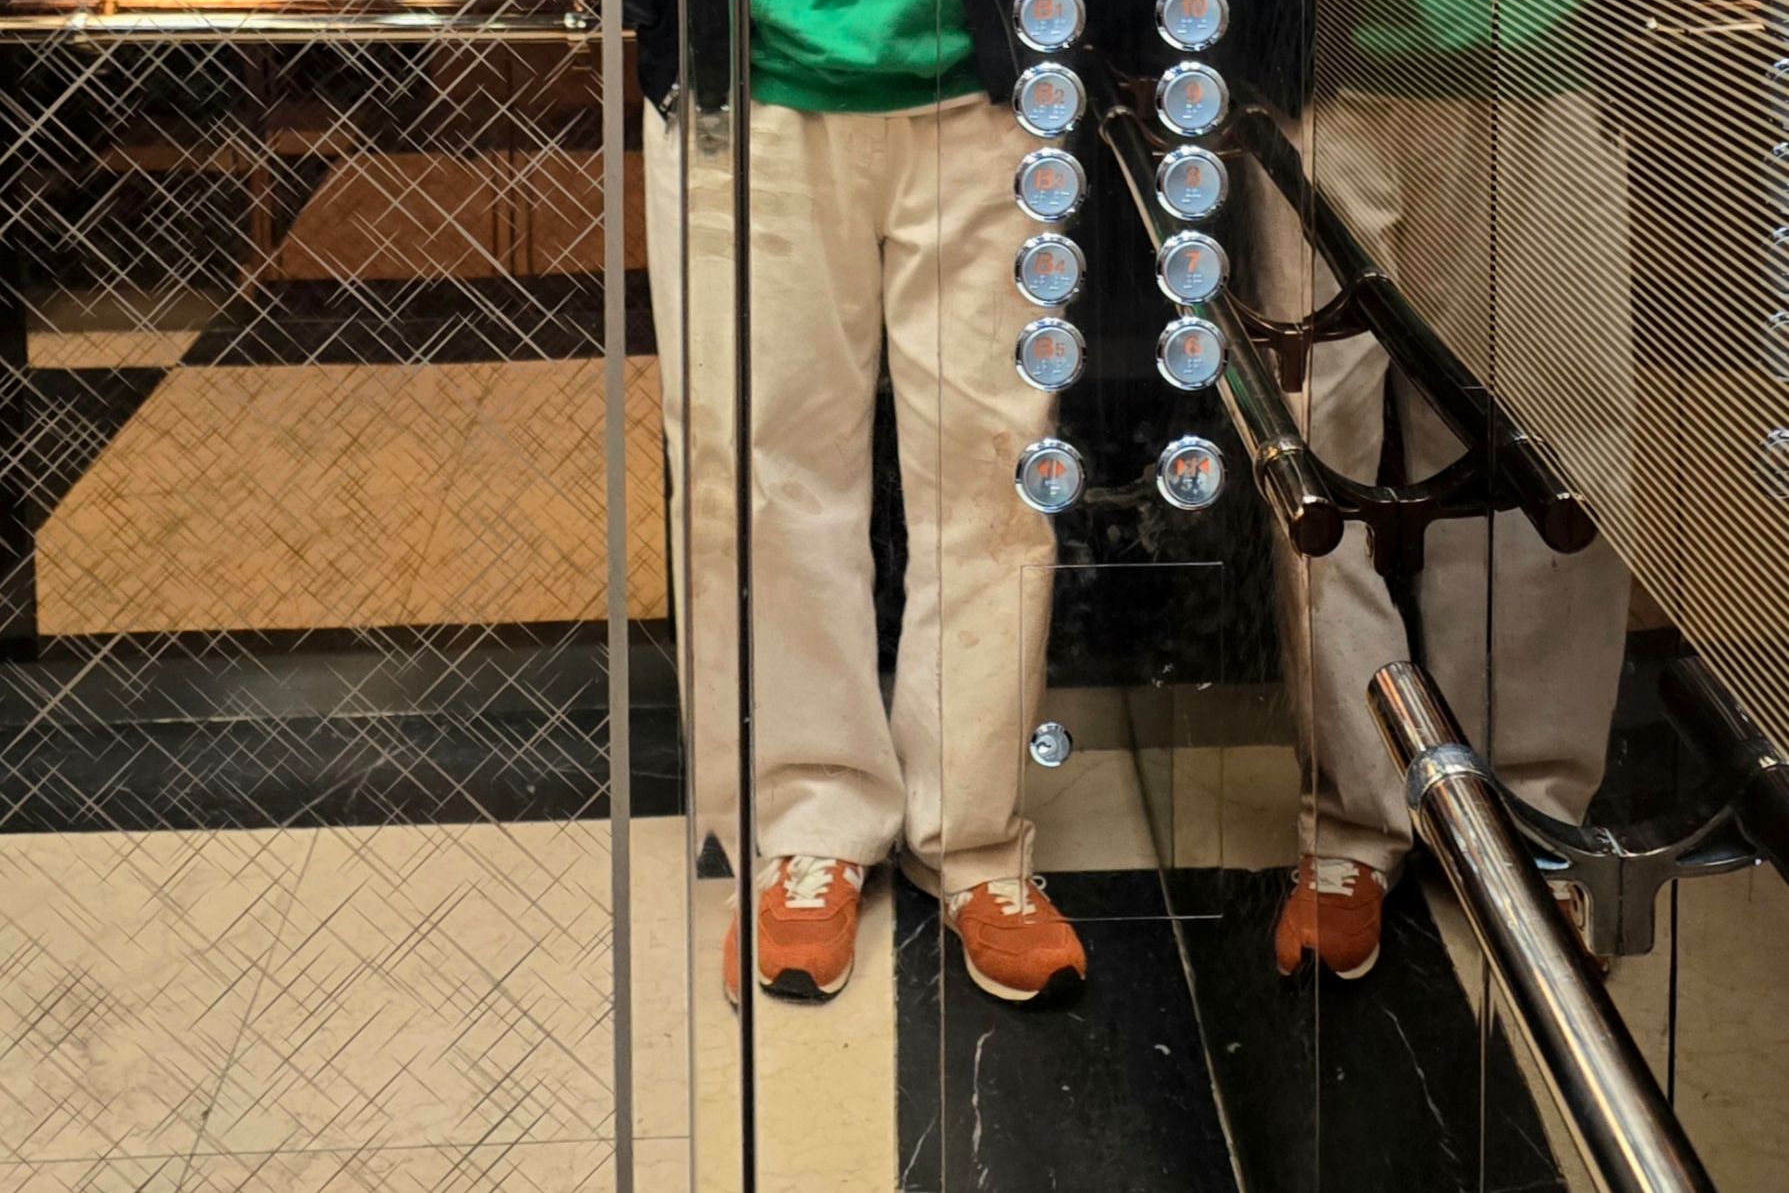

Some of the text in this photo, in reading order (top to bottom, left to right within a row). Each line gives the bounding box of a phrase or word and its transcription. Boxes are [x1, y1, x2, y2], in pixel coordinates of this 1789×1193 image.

[1034, 83, 1065, 105] B2
[1185, 83, 1203, 104] 9
[1034, 168, 1065, 190] B3
[1186, 166, 1202, 187] 8
[1034, 252, 1066, 275] B4
[1185, 250, 1202, 273] 7
[1034, 336, 1066, 359] B5
[1184, 335, 1203, 357] 6
